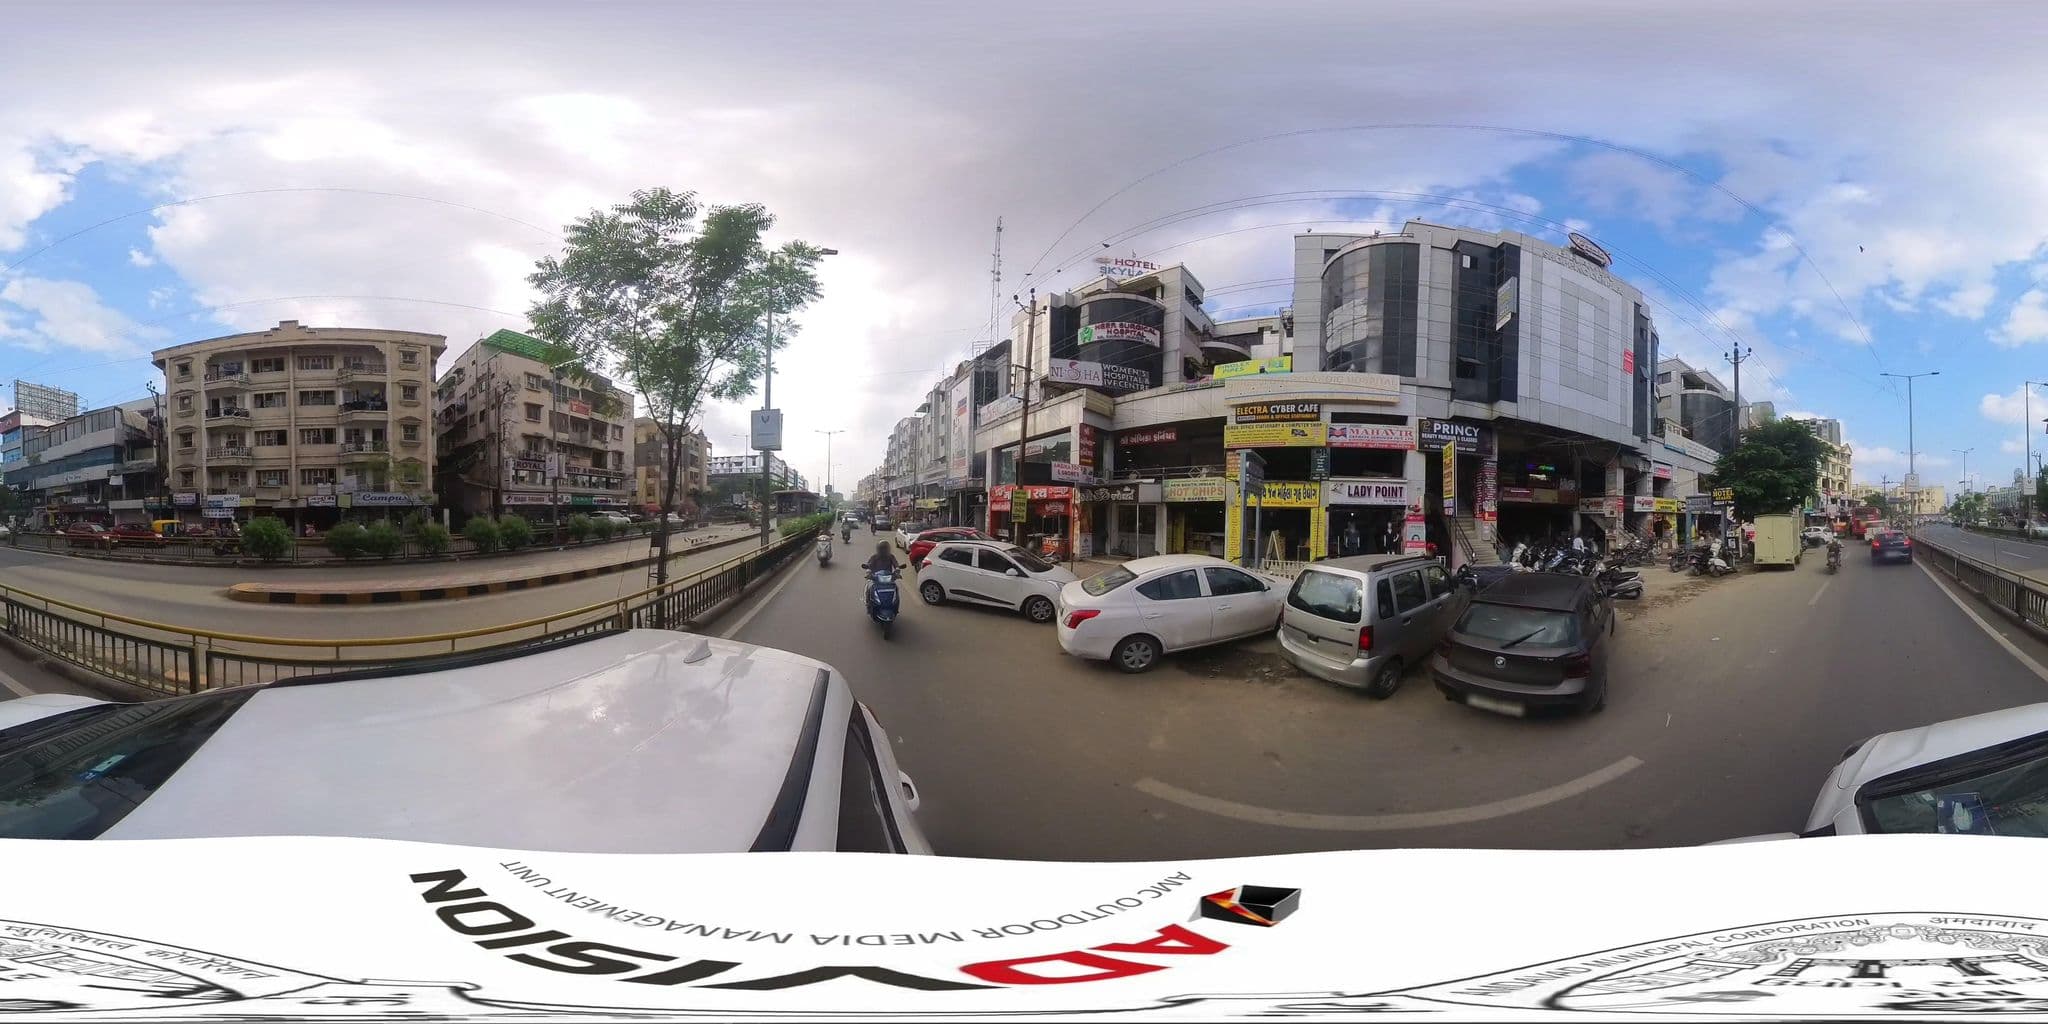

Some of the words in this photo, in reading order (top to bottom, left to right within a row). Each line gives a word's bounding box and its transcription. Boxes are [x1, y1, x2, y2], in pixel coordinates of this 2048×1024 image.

[1115, 258, 1157, 270] HOTEL
[1106, 328, 1146, 338] HOSPITAL
[1103, 363, 1147, 377] WOMEN'S
[1104, 371, 1141, 383] HOSPITAL
[1236, 405, 1268, 416] ELECTRA
[1270, 404, 1296, 414] CYBER
[1297, 403, 1319, 413] CAFE
[1349, 428, 1413, 437] MAHAVIR
[1433, 422, 1480, 437] PRINCY
[517, 461, 541, 470] ROYAL
[1169, 488, 1190, 497] HOT
[1192, 486, 1224, 497] CHIPS
[1347, 485, 1373, 498] LADY
[1374, 486, 1404, 499] POINT
[1712, 488, 1734, 497] HOTEL
[362, 493, 409, 503] Campus
